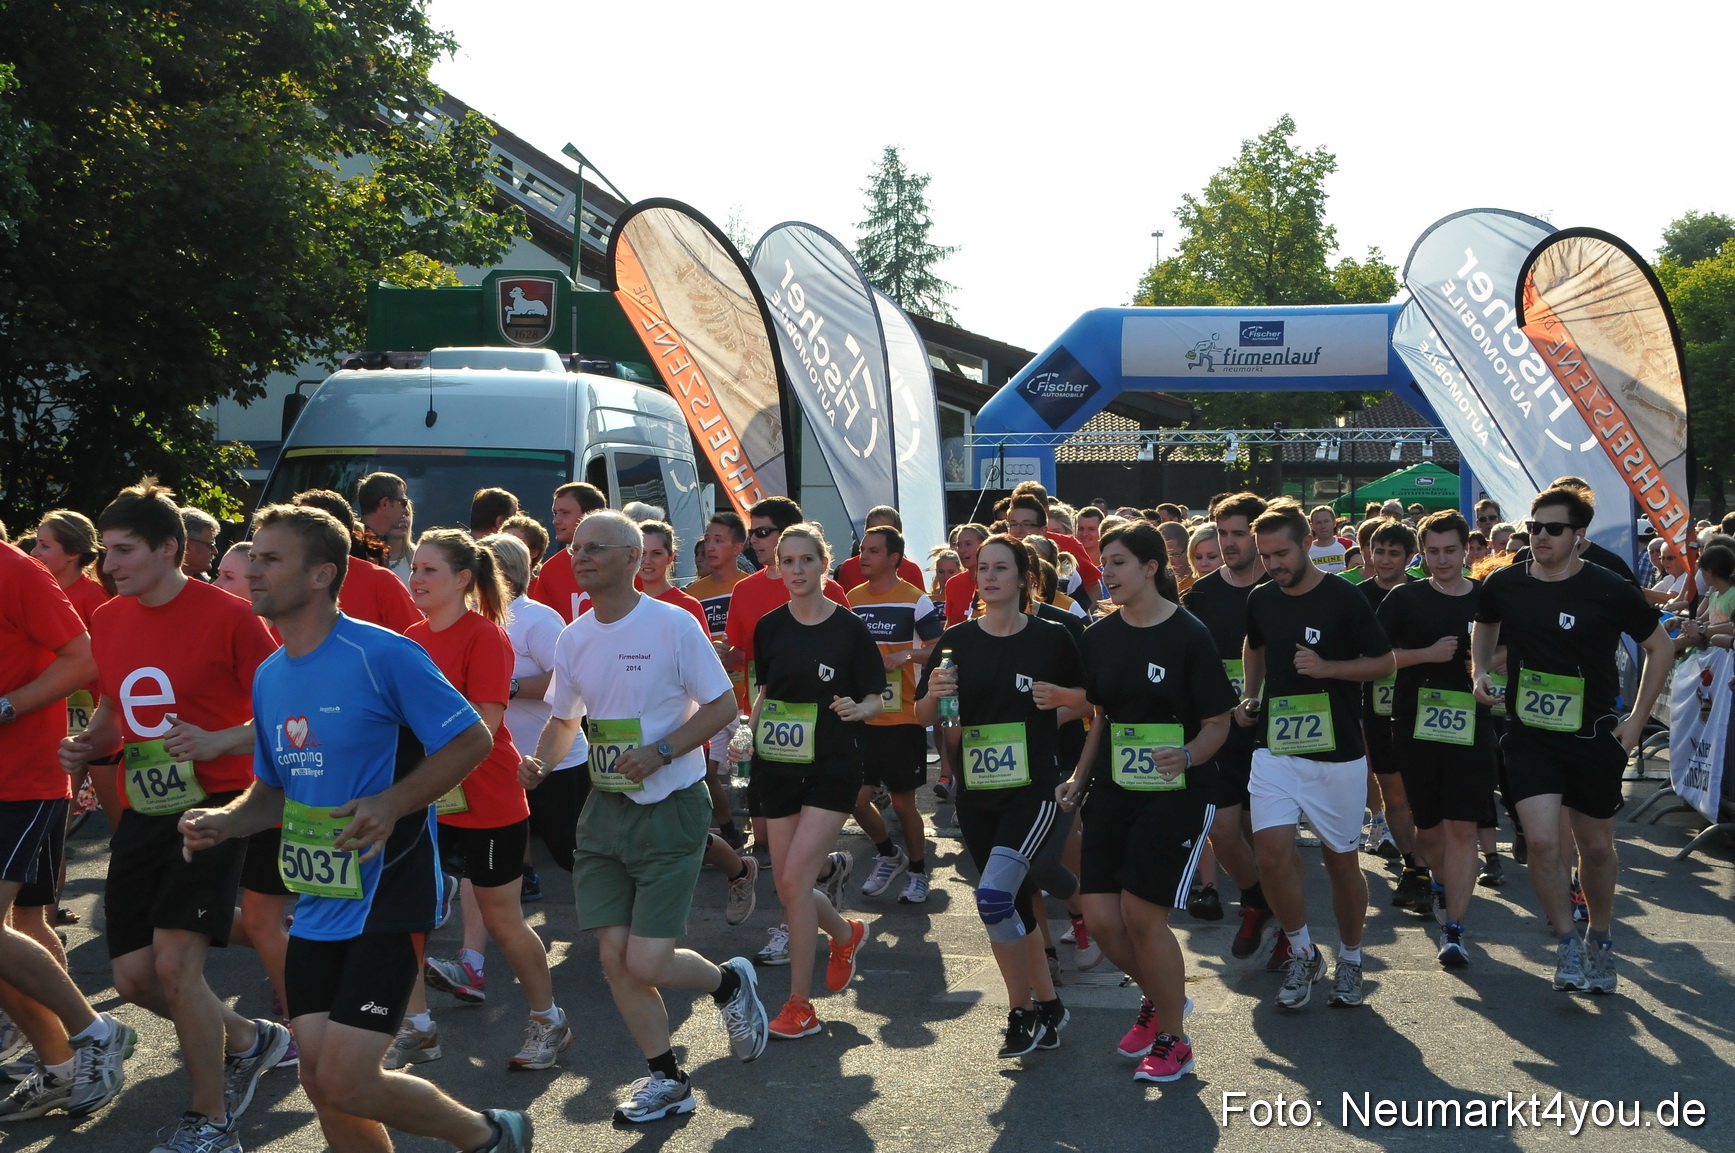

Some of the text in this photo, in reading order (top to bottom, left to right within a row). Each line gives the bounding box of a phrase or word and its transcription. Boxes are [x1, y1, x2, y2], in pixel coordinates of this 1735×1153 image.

[514, 329, 540, 340] 1628
[1248, 328, 1282, 338] Fischer
[1223, 346, 1323, 365] firmenlauf
[1036, 380, 1089, 393] Fischer
[866, 620, 897, 631] scher
[119, 666, 178, 738] e
[1524, 690, 1572, 717] 267
[1275, 714, 1323, 741] 272
[1423, 707, 1467, 731] 265
[276, 724, 284, 752] I
[762, 720, 805, 748] 260
[277, 747, 323, 768] camping
[969, 744, 1017, 774] 264
[1120, 747, 1159, 774] 25
[132, 764, 187, 799] 184
[282, 843, 353, 885] 5037
[370, 1005, 389, 1016] asics
